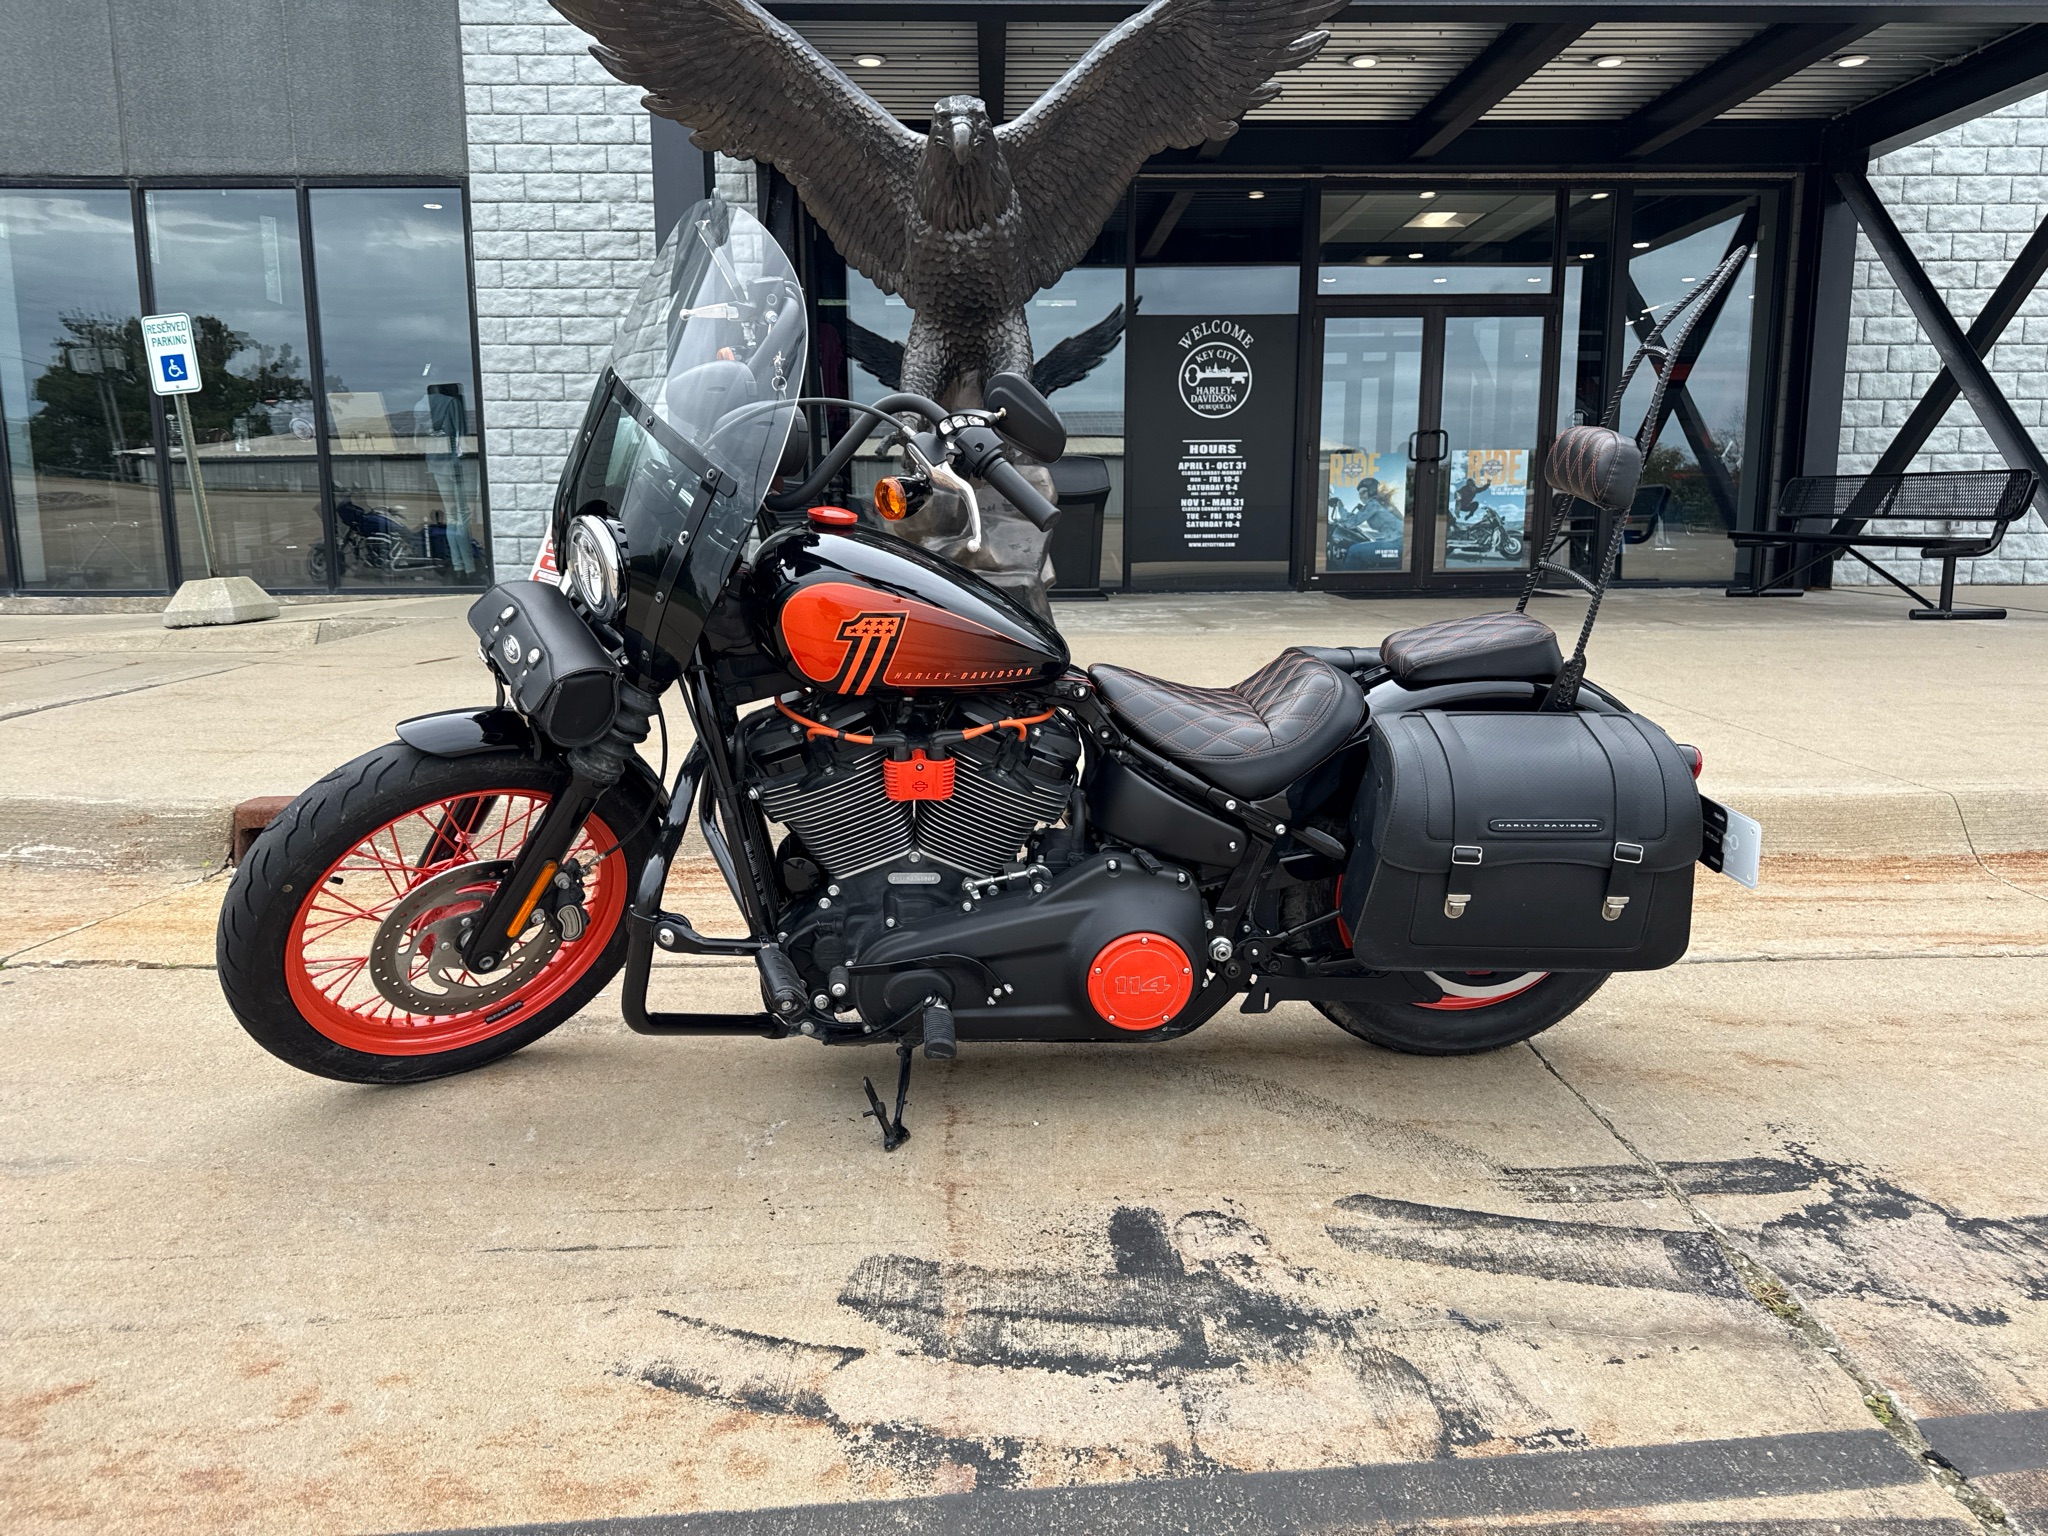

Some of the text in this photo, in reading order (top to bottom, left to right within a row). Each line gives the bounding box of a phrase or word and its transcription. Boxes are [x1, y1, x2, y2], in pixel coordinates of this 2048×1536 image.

[146, 321, 187, 334] RESERVED
[1178, 320, 1254, 349] WELCOME
[151, 335, 187, 347] PARKING
[1195, 349, 1238, 363] KEY CITY
[1196, 386, 1235, 395] HARLEY-
[1191, 394, 1237, 403] DAVIDSON
[1189, 444, 1237, 454] HOURS
[1178, 462, 1203, 470] APRIL
[1205, 462, 1210, 470] 1
[1216, 462, 1234, 470] OCT
[1235, 461, 1247, 470] 31
[1233, 498, 1244, 506] 31
[894, 667, 1033, 680] HARLEY-DAVIDSON
[1115, 976, 1171, 994] 114
